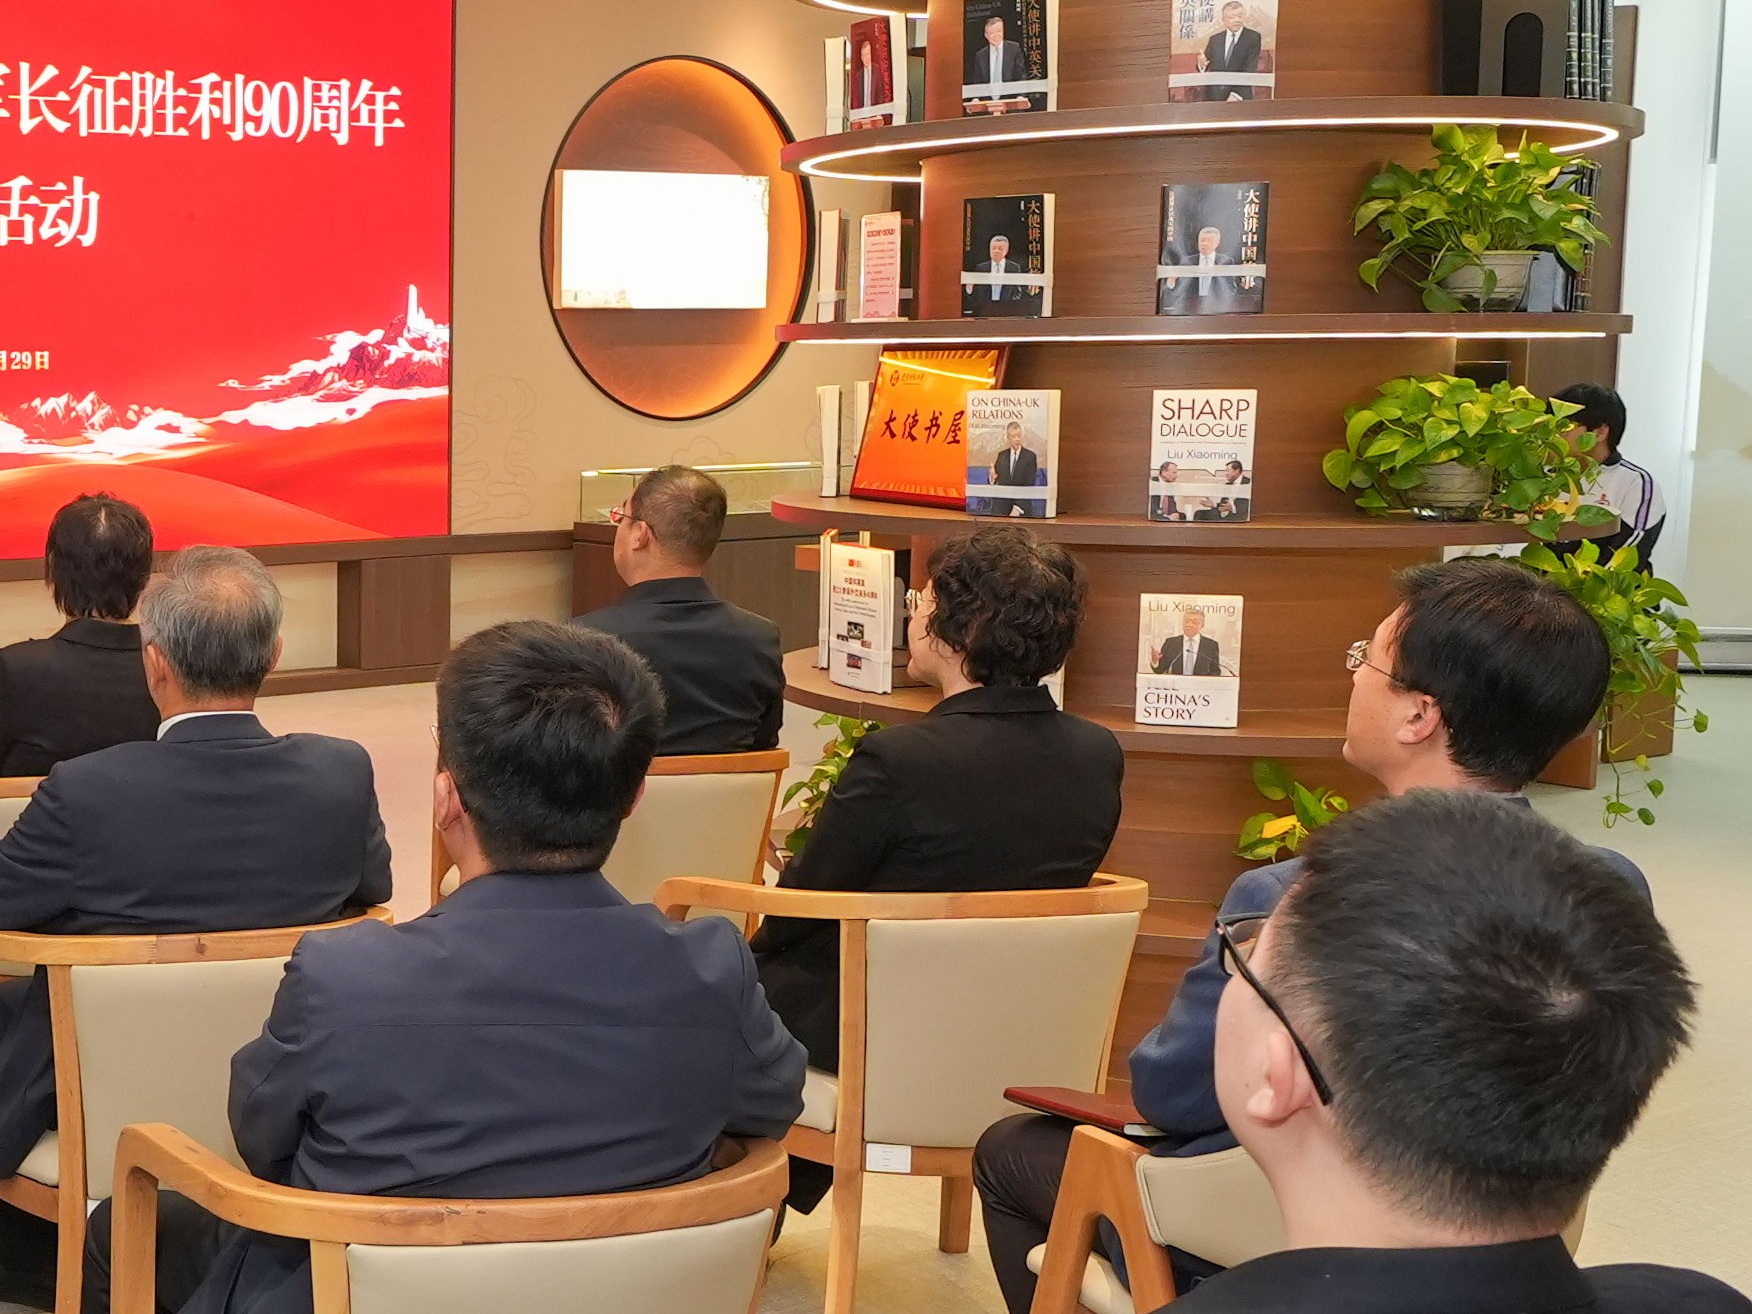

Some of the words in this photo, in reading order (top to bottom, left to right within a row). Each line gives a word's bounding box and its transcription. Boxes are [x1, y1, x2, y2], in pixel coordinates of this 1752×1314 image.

[971, 397, 989, 408] ON
[990, 397, 1040, 409] CHINA-UK
[1160, 398, 1250, 421] SHARP
[971, 409, 1024, 420] RELATIONS
[879, 408, 966, 446] 大使书屋
[1159, 422, 1248, 438] DIALOGUE
[1167, 449, 1184, 459] Liu
[1186, 449, 1238, 461] Xiaoming
[1148, 600, 1168, 612] Liu
[1172, 601, 1237, 616] Xiaoming
[1144, 691, 1211, 707] CHINA'S
[1143, 706, 1196, 720] STORY
